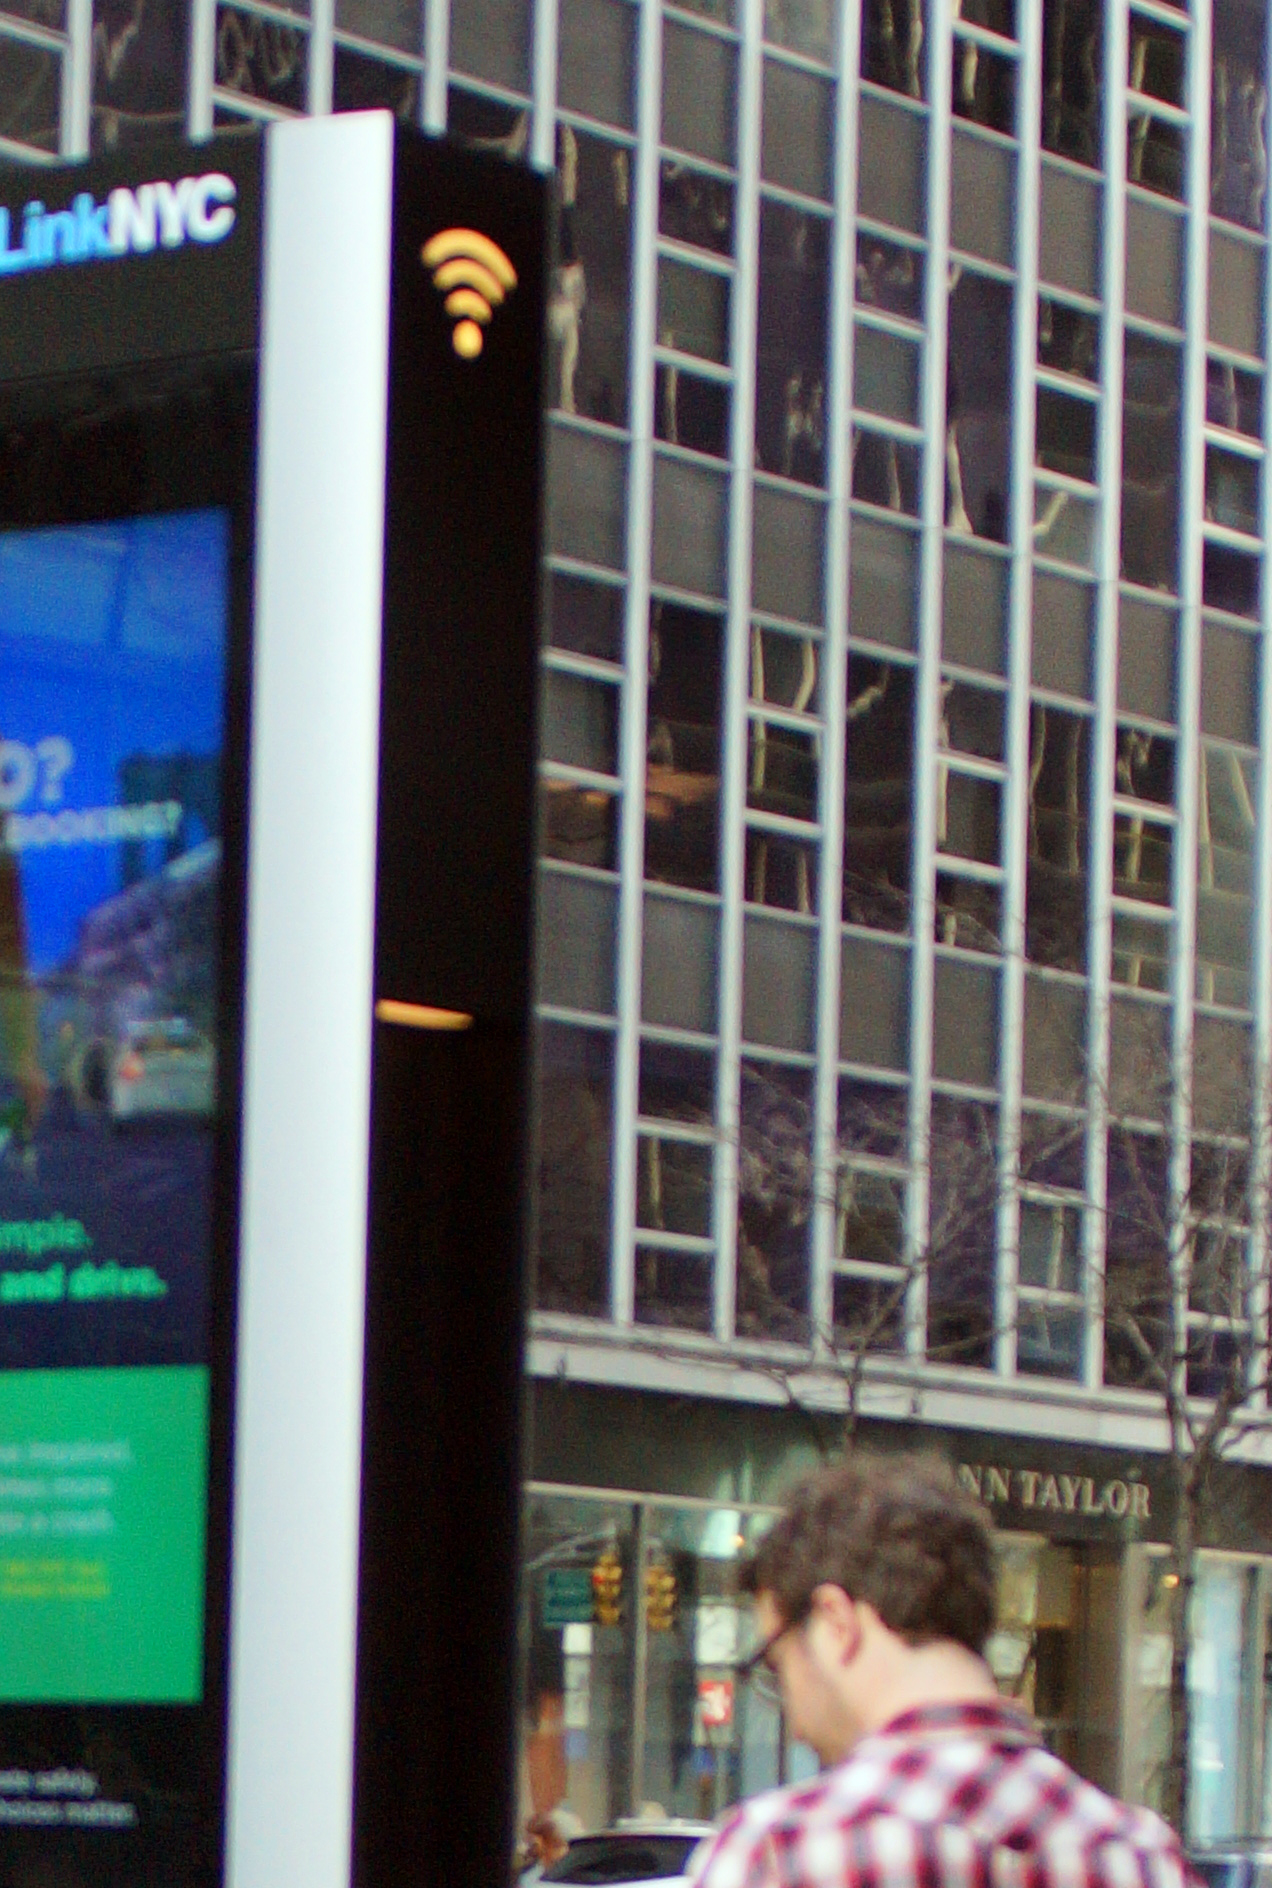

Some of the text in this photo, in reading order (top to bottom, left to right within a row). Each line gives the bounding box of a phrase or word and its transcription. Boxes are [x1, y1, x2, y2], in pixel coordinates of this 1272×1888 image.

[5, 800, 182, 847] BOOKING?
[68, 1260, 167, 1299] drive.
[958, 1463, 1152, 1518] NN TAYLOR
